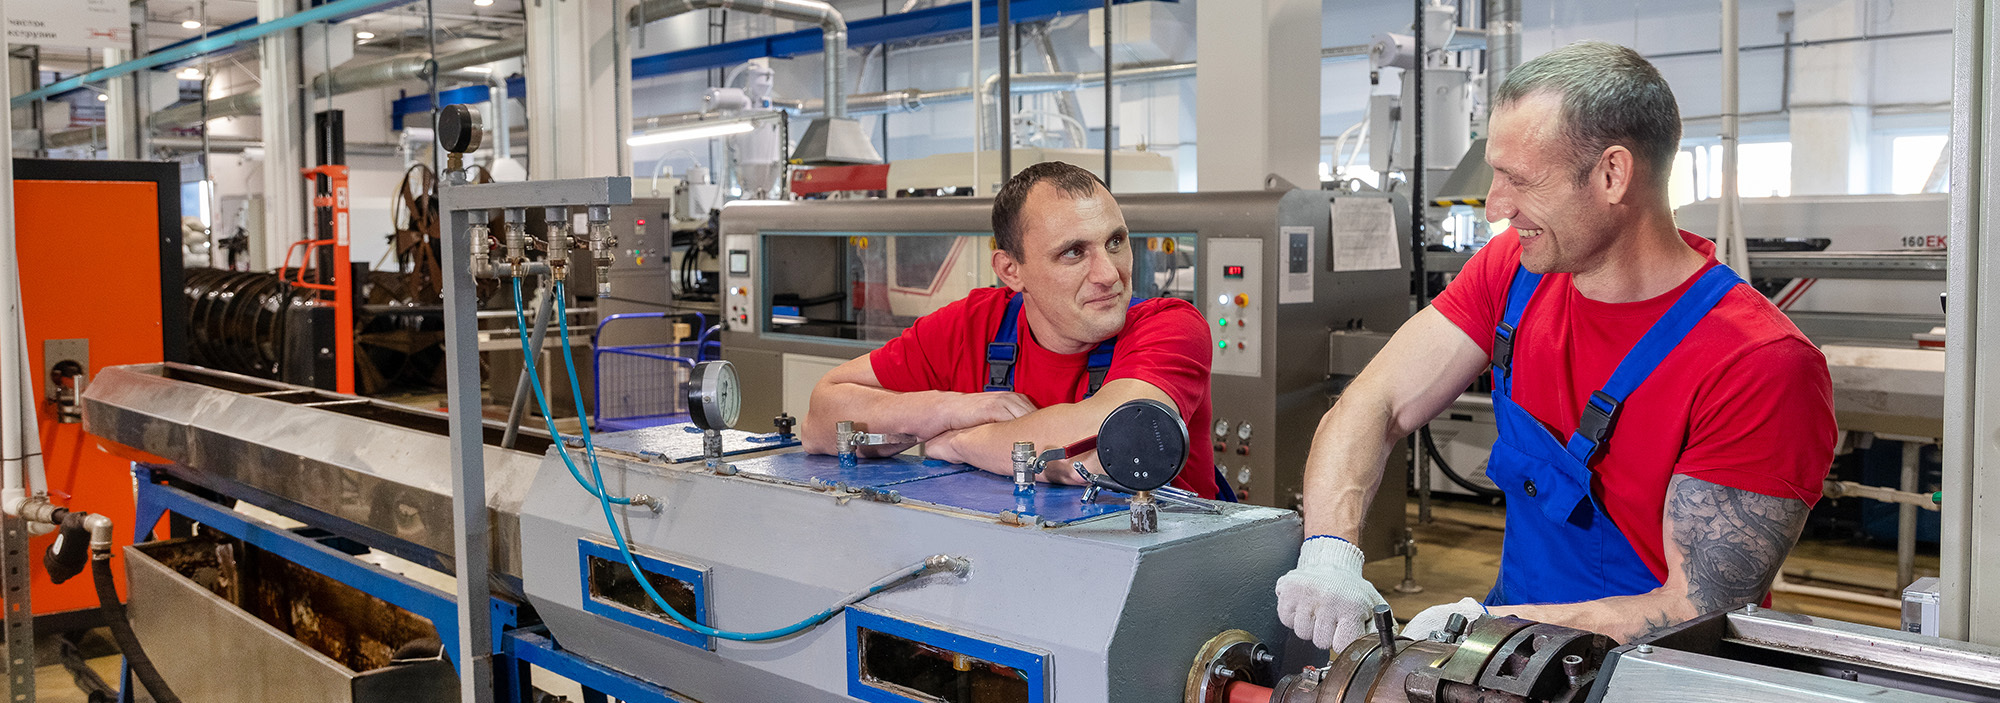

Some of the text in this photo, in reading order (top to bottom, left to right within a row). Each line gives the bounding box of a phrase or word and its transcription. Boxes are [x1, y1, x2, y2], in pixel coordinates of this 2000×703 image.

[7, 17, 45, 28] часток
[7, 29, 57, 39] кструзии
[1901, 234, 1947, 248] 160EK
